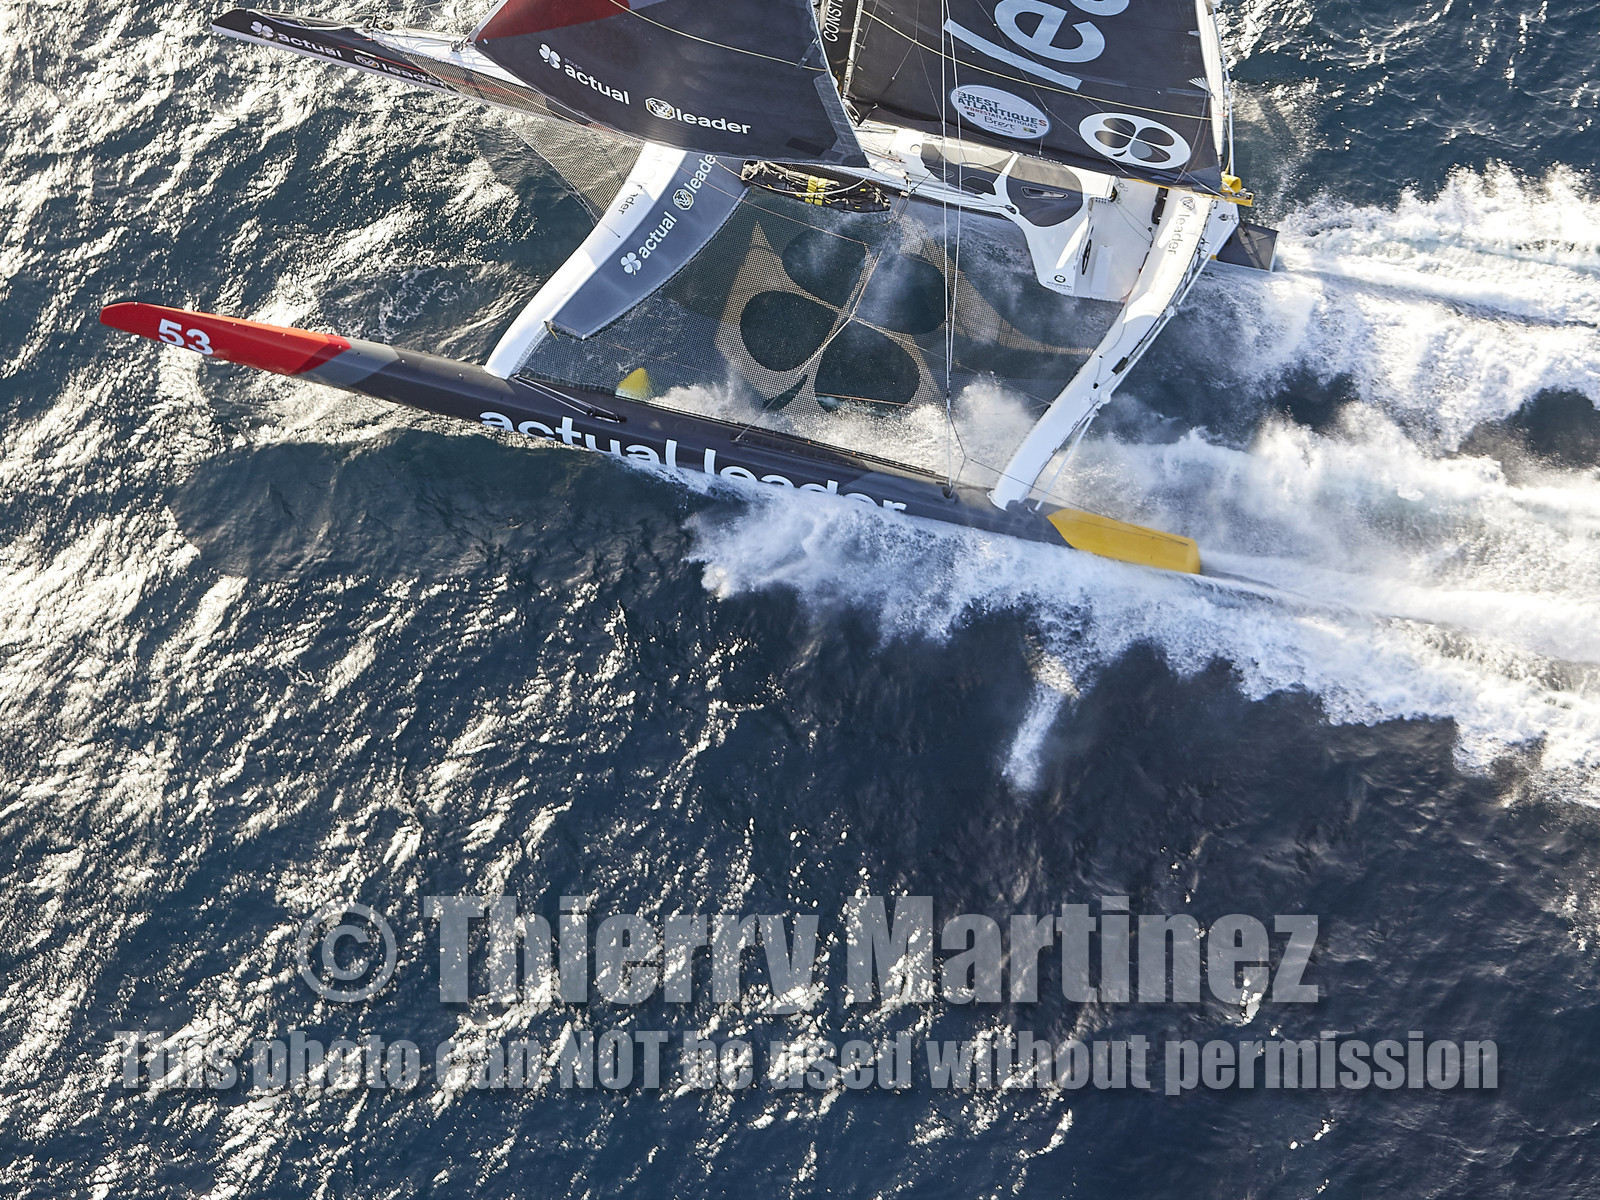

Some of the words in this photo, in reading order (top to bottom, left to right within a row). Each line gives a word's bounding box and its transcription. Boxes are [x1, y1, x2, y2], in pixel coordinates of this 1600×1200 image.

[277, 32, 343, 58] actual
[564, 64, 630, 105] actual
[676, 107, 751, 134] leader
[957, 90, 1000, 108] BREST
[957, 97, 1047, 127] ATLANTIQUES
[638, 211, 678, 259] actual
[683, 153, 718, 194] leade
[1167, 214, 1192, 255] leader
[158, 318, 214, 356] 53
[480, 411, 678, 469] actual
